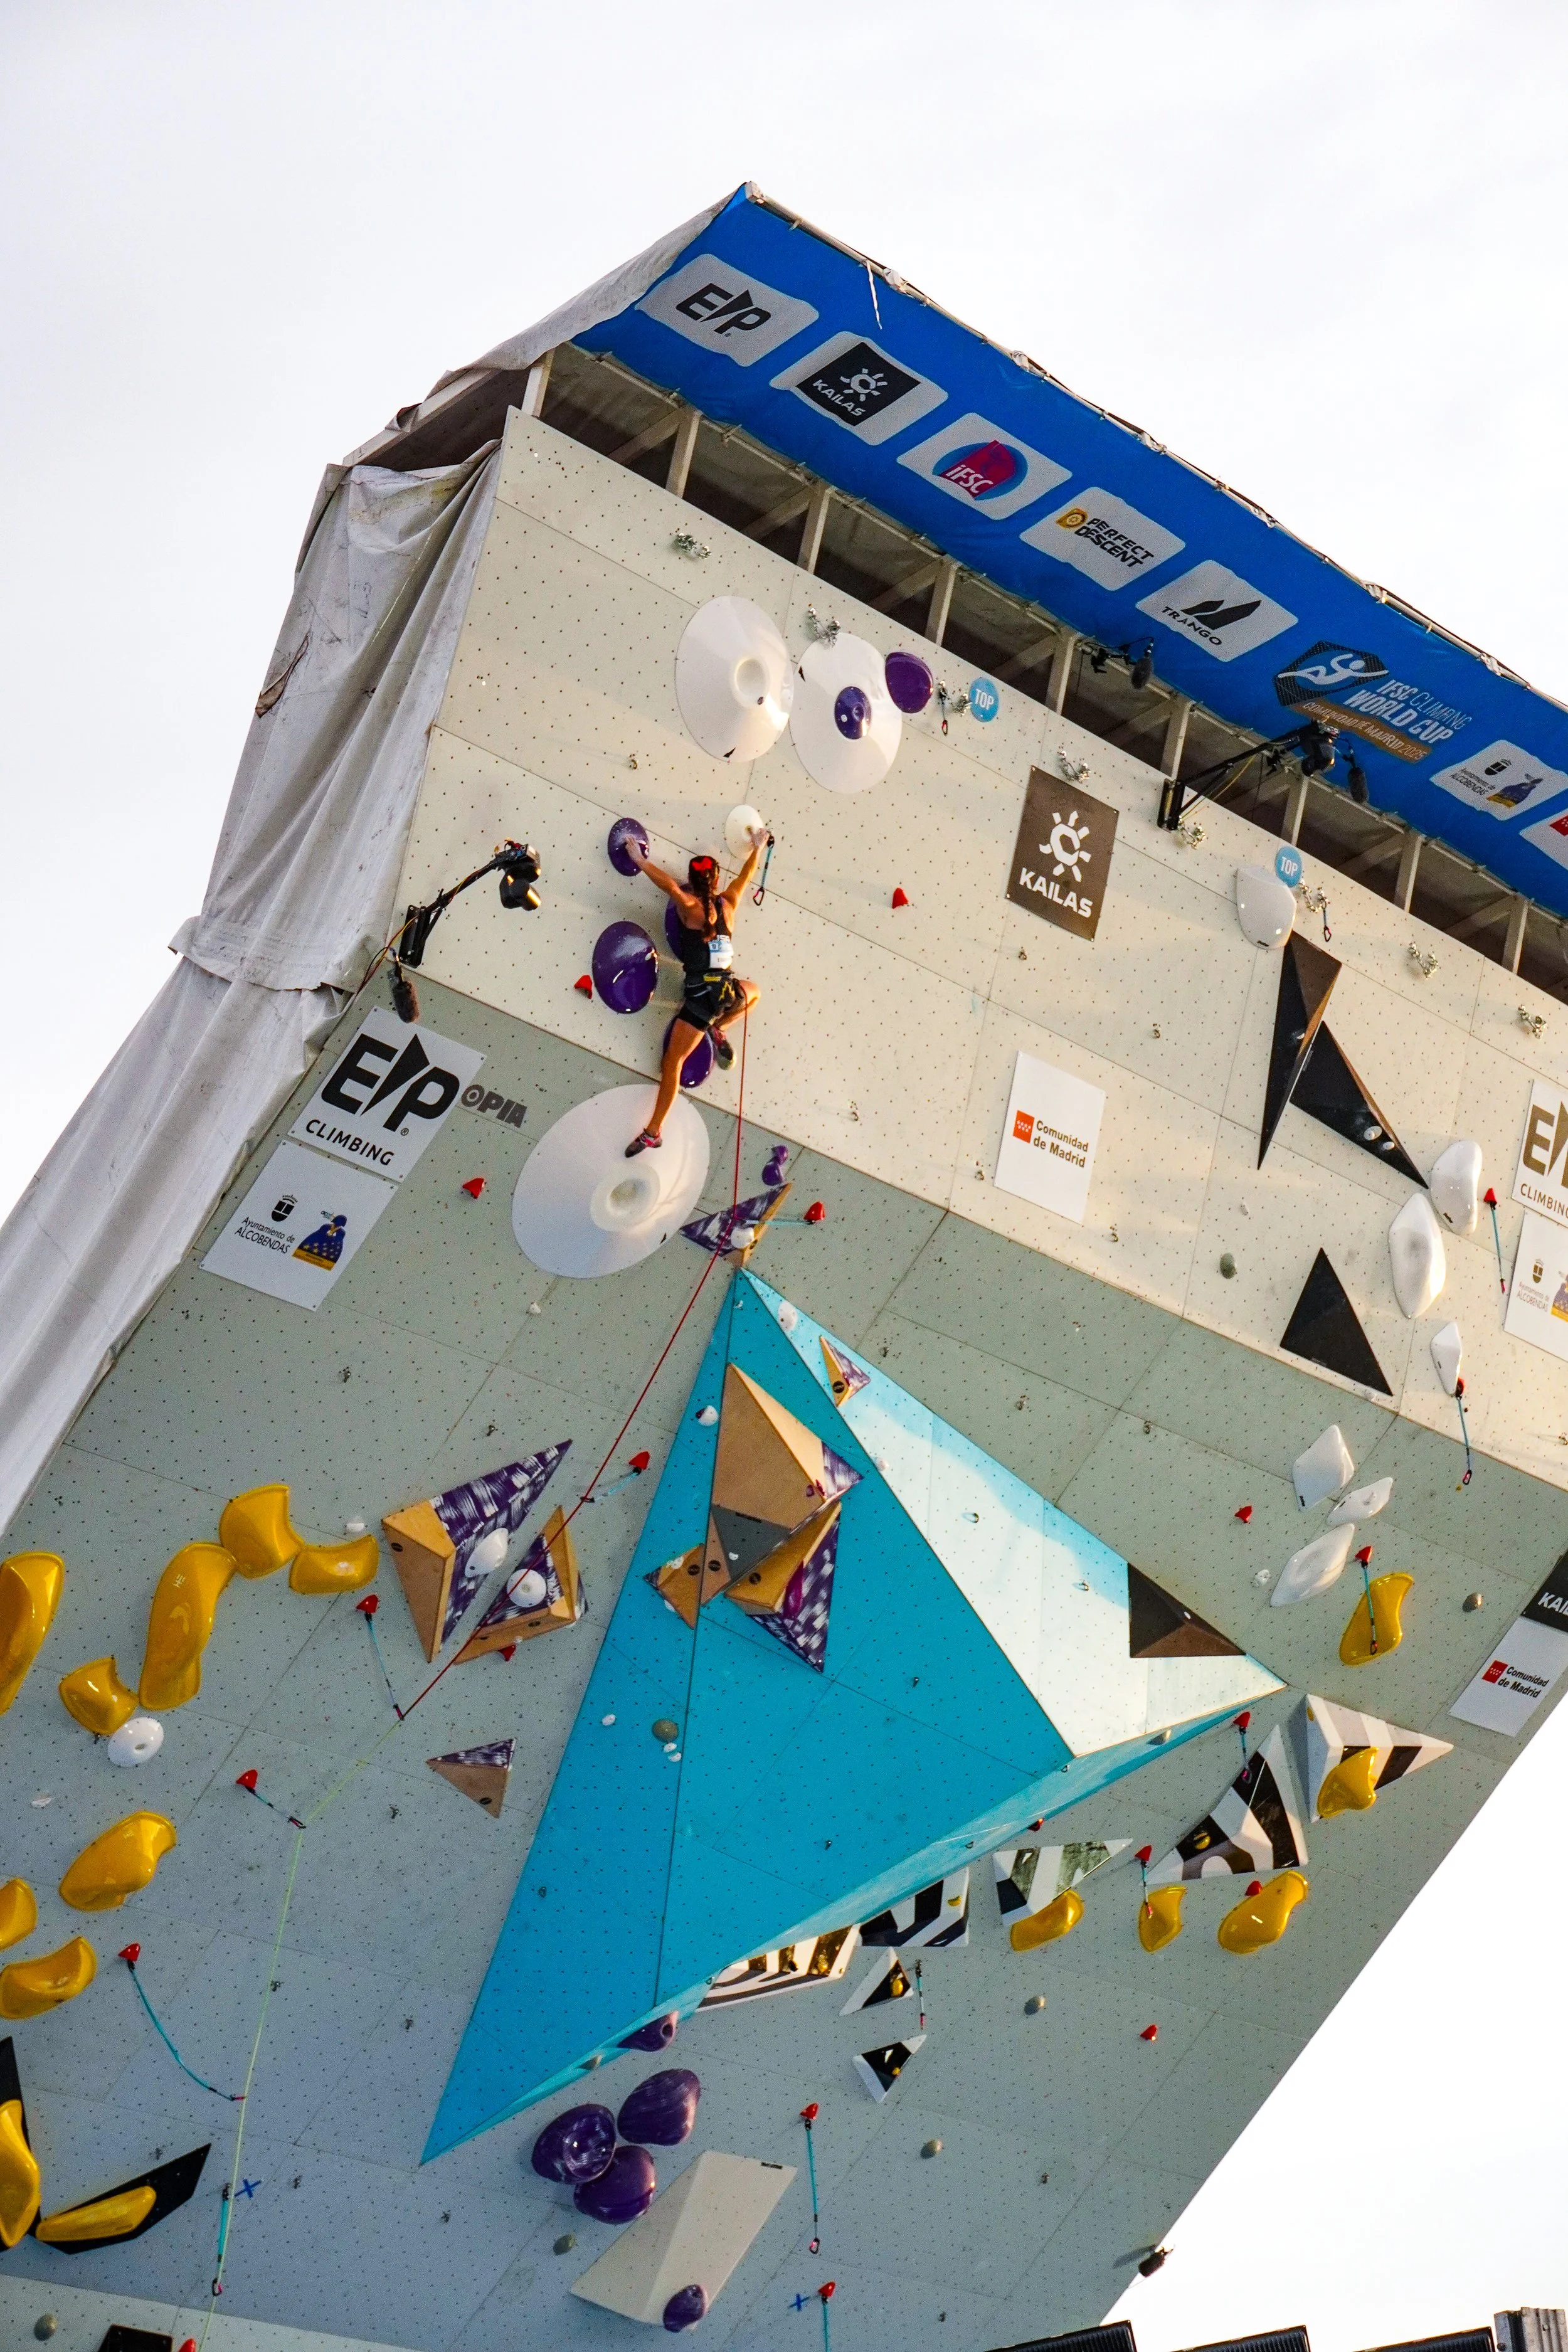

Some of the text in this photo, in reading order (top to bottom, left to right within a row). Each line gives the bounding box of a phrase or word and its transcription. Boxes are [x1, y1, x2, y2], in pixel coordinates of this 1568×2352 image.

[812, 379, 867, 418] KAILAS
[1074, 526, 1143, 567] DESCENT
[1087, 517, 1155, 559] PERFECT
[1162, 606, 1222, 645] TRANGO
[975, 688, 994, 710] TOP
[1377, 679, 1472, 729] IFSC CLIMBING
[1343, 689, 1454, 743] WORLD CUP
[1364, 724, 1404, 750] MADRID
[1281, 856, 1298, 876] TOP
[1019, 867, 1093, 918] KAILAS
[305, 1119, 394, 1166] CLIMBING
[1034, 1136, 1086, 1168] de Madrid
[1036, 1120, 1089, 1152] Comunidad
[235, 1227, 290, 1254] ALCOBENDAS
[241, 1217, 295, 1243] Ayuntamiento de
[1498, 1678, 1541, 1698] de Madrid
[1506, 1666, 1549, 1687] Comunidad
